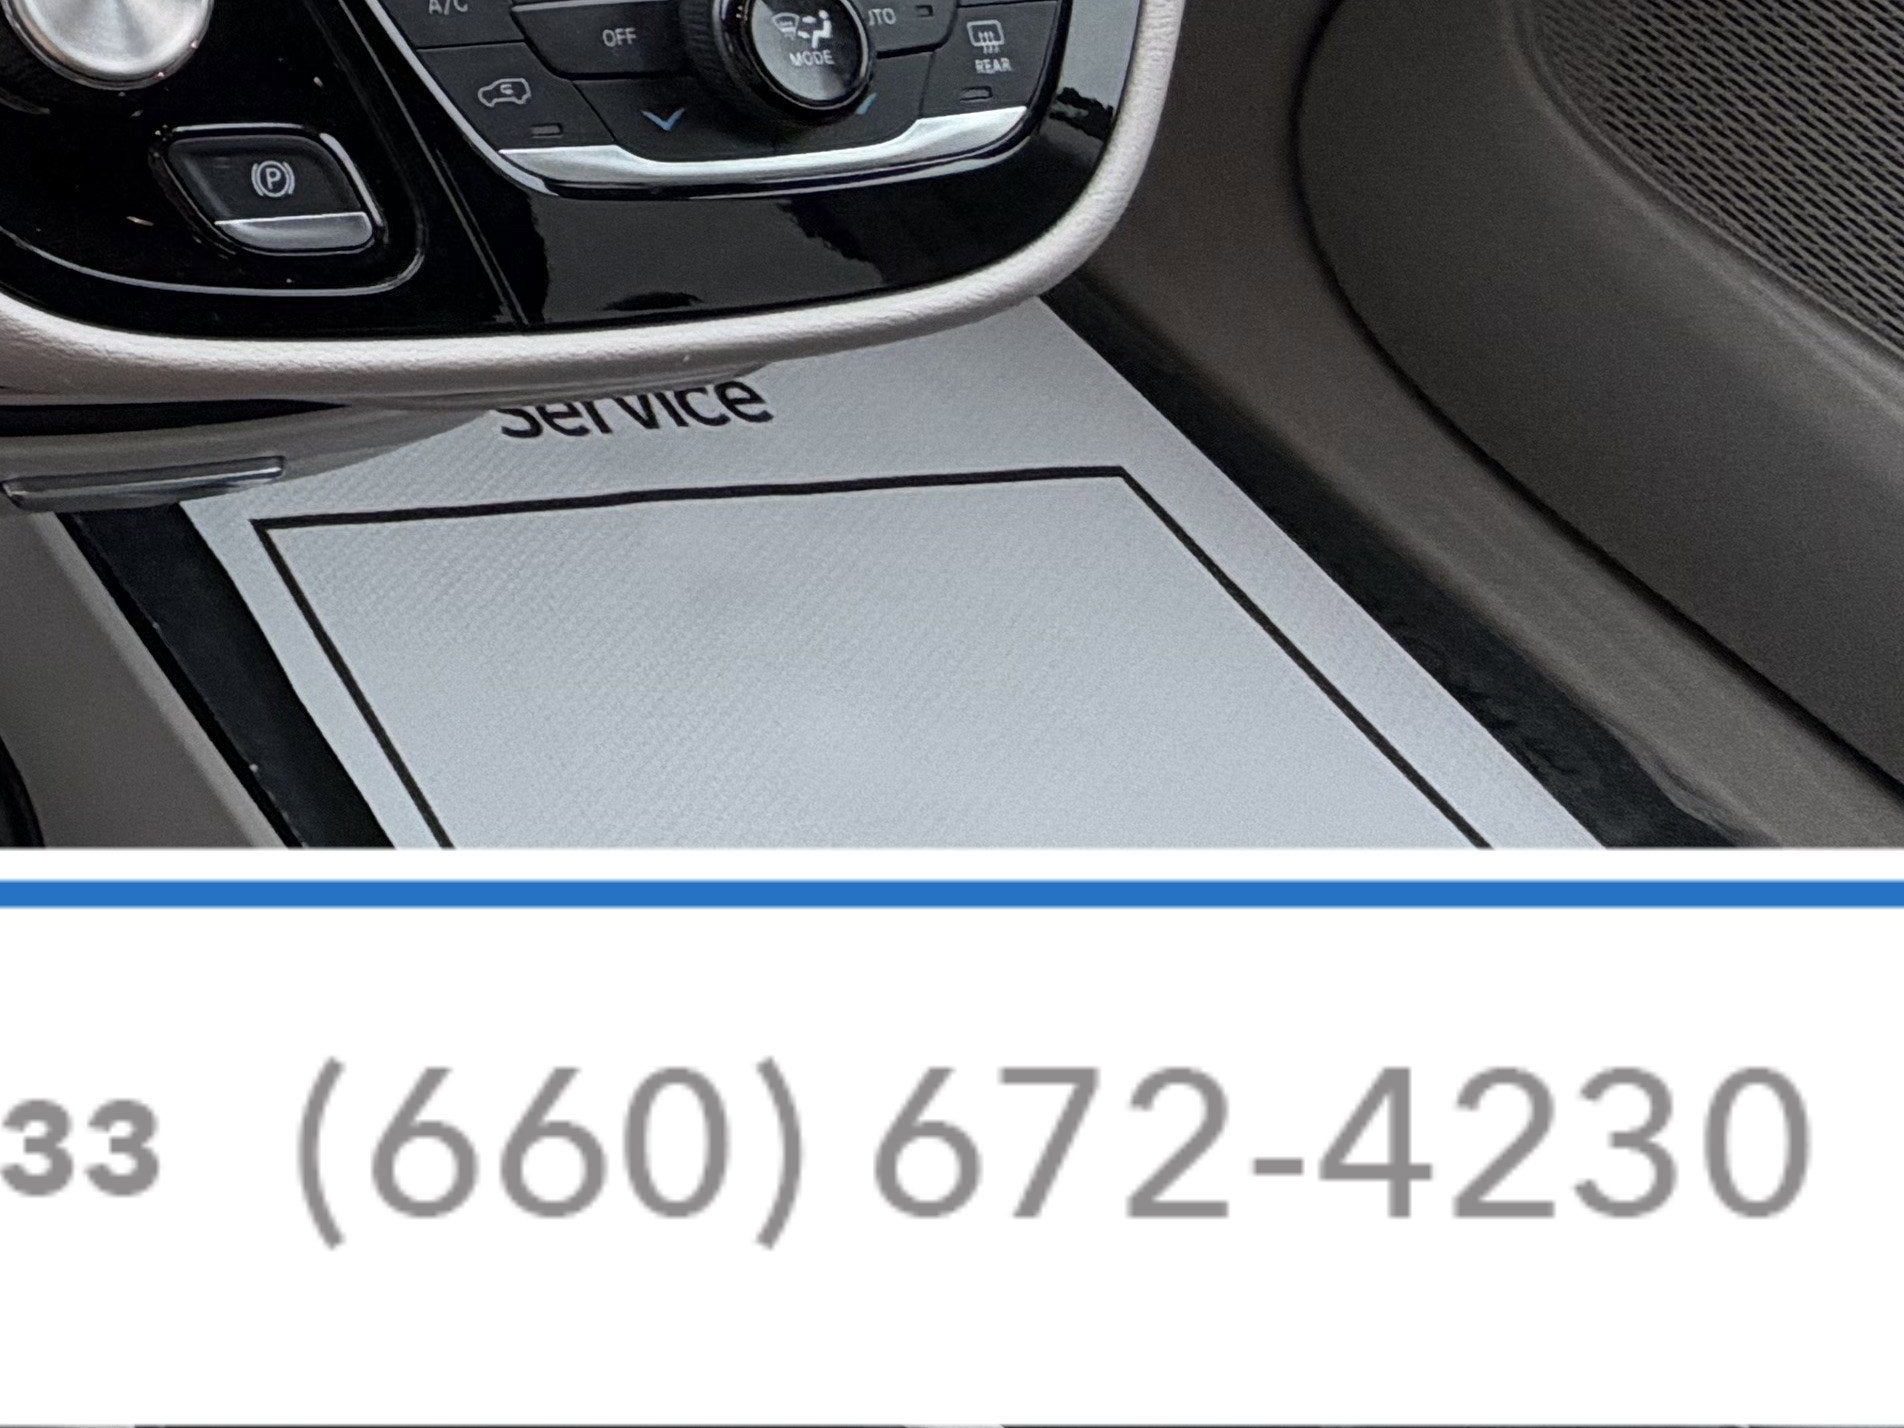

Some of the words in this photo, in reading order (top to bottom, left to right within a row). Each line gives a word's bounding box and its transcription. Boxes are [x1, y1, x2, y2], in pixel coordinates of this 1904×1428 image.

[602, 27, 637, 48] OFF
[788, 50, 834, 67] MODE
[974, 56, 1012, 75] REAR
[494, 380, 775, 439] Service
